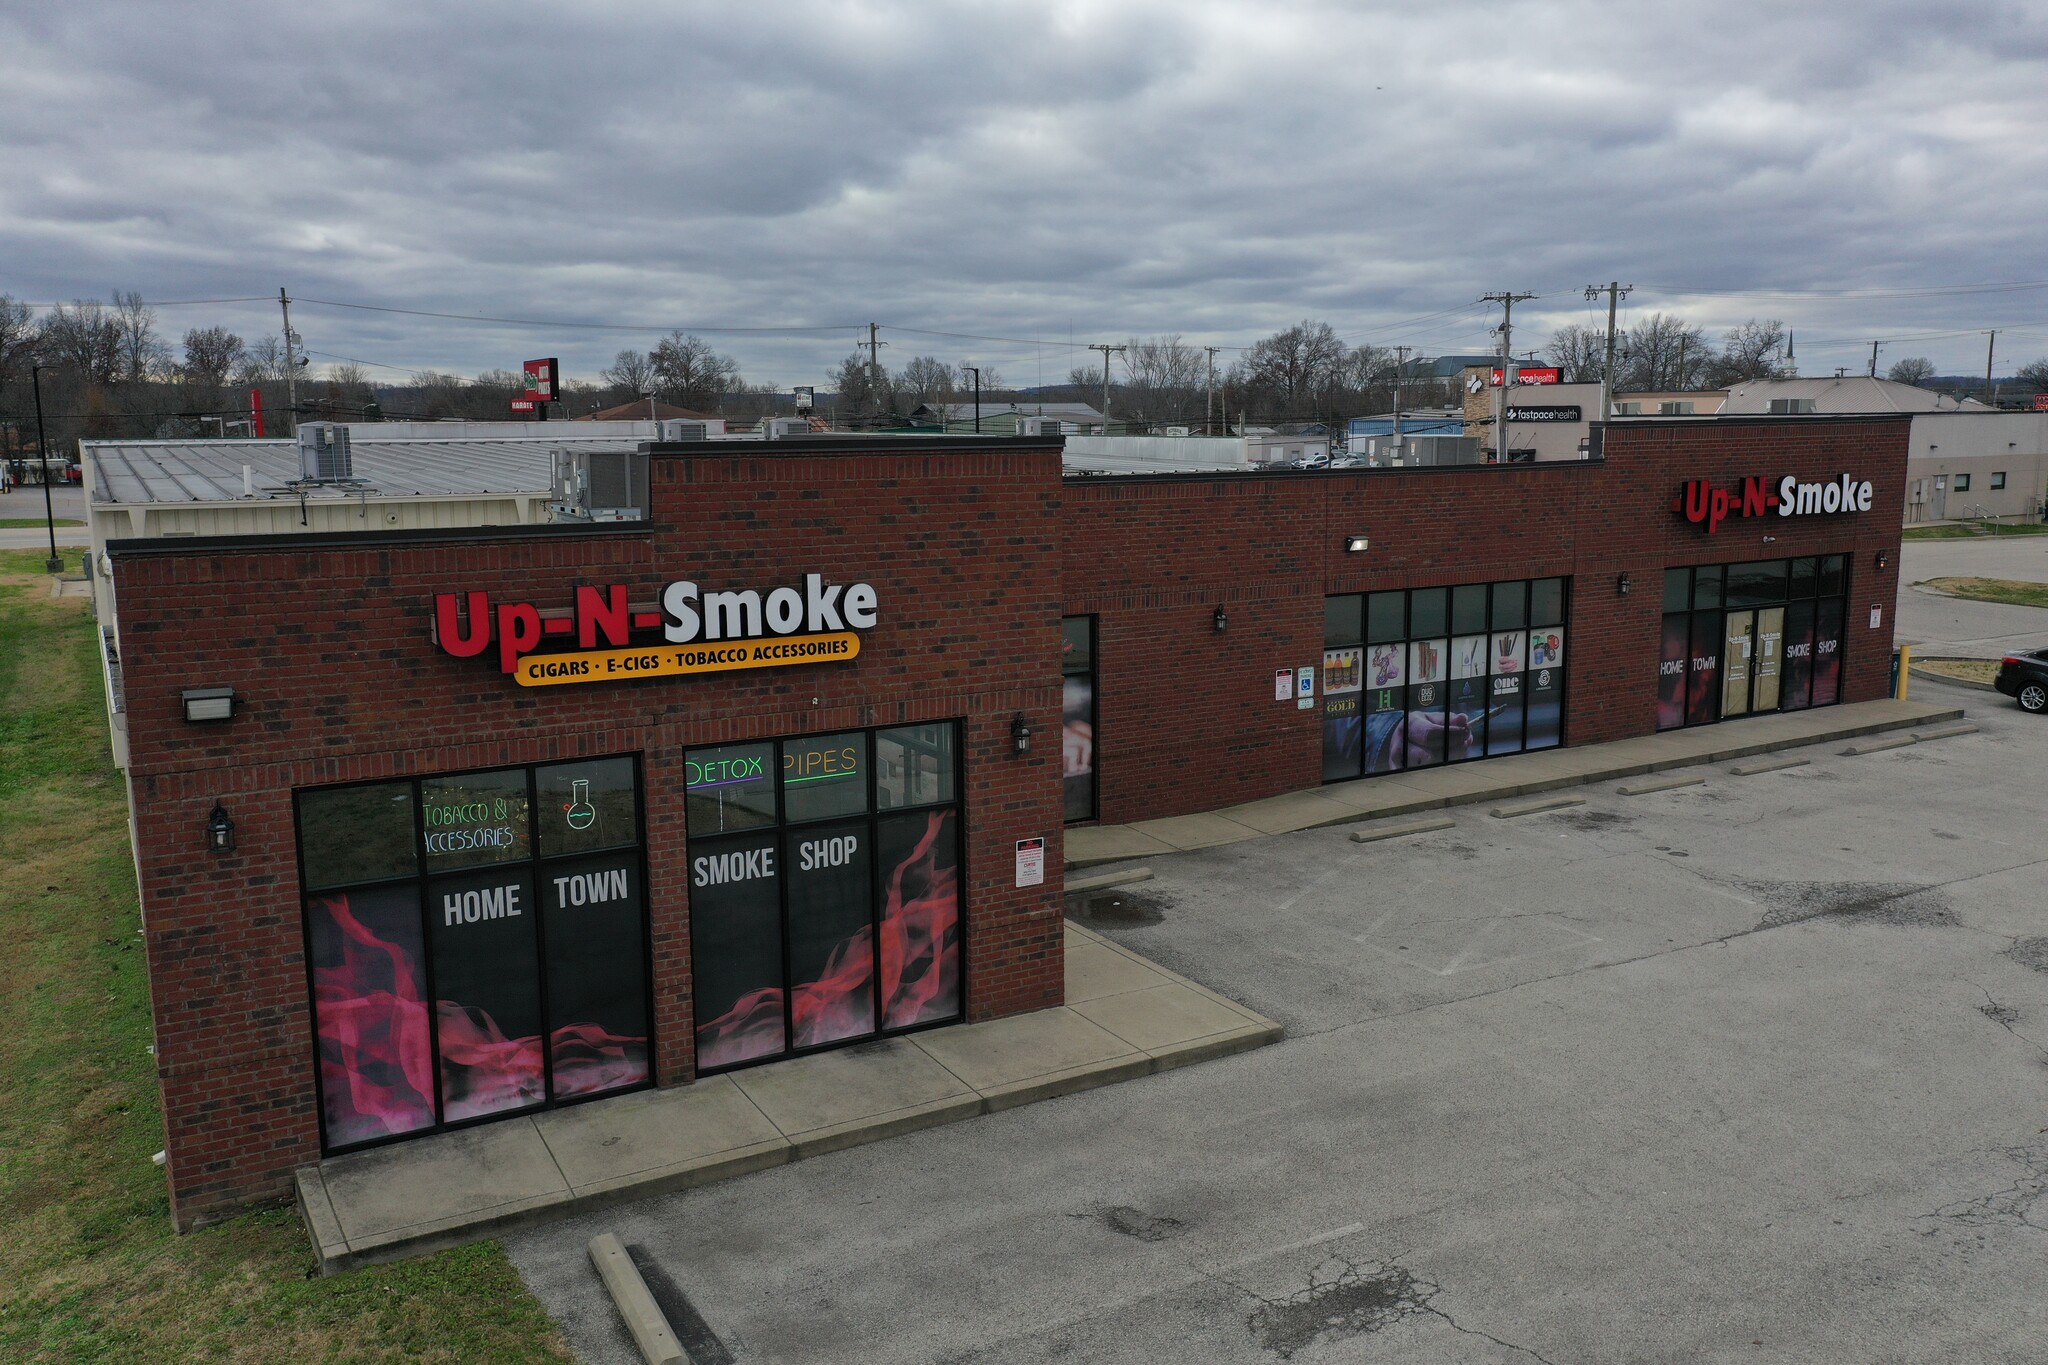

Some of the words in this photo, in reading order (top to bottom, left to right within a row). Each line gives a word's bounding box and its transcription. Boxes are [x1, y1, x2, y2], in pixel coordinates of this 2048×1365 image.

[1685, 473, 1873, 534] Up-N-Smoke
[435, 573, 877, 674] Up-N-Smoke
[528, 660, 589, 679] CIGARS
[606, 655, 660, 673] E-CIGS
[675, 649, 748, 667] TOBACCO
[752, 640, 849, 660] ACCESSORIES
[1787, 643, 1810, 659] SMOKE
[1818, 640, 1837, 654] SHOP
[1660, 659, 1684, 676] HOME
[1692, 656, 1716, 671] TOWN
[1327, 701, 1356, 712] GOLD
[685, 756, 763, 785] DETOX
[783, 747, 857, 776] PIPES
[422, 803, 489, 827] TOBACCO
[494, 797, 508, 820] &
[694, 847, 775, 888] SMOKE
[799, 835, 858, 871] SHOP
[443, 884, 522, 927] HOME
[553, 869, 628, 909] TOWN
